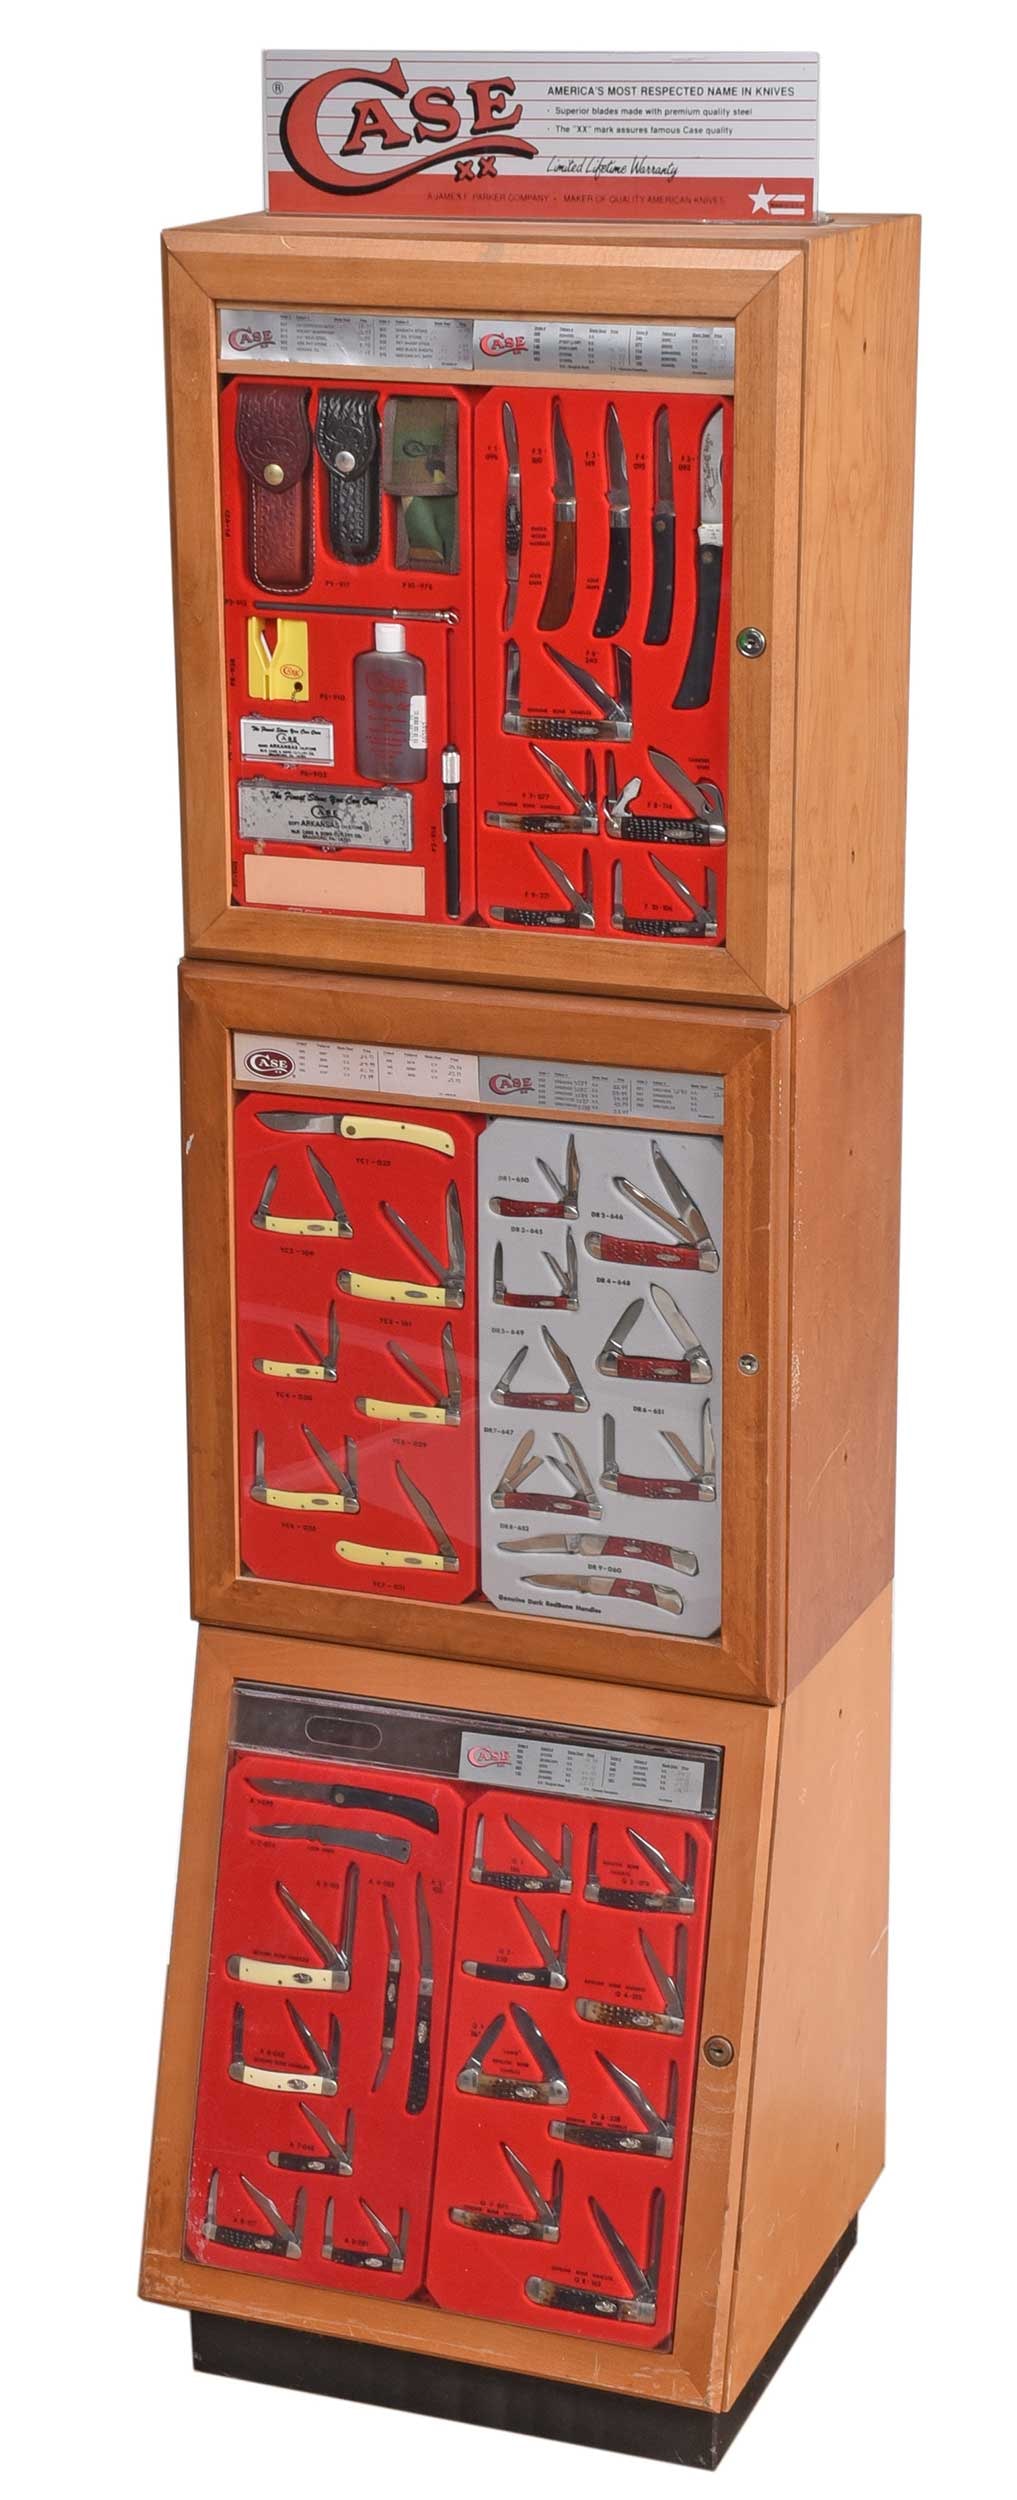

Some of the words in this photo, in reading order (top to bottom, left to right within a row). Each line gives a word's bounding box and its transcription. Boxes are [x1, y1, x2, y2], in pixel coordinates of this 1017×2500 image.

[547, 86, 604, 97] AMERICA'S
[607, 86, 637, 97] MOST
[640, 86, 704, 97] RESPECTED
[707, 86, 738, 97] NAME
[741, 86, 752, 97] IN
[755, 86, 795, 97] KNIVES
[555, 106, 589, 116] Superior
[592, 107, 618, 115] blades
[621, 107, 643, 116] made
[645, 107, 662, 116] with
[664, 107, 700, 117] premium
[703, 107, 730, 117] quality
[733, 108, 753, 116] steel
[279, 58, 539, 196] CASE
[555, 125, 570, 133] The
[594, 126, 614, 134] mark
[650, 126, 680, 134] famous
[683, 126, 703, 135] Case
[705, 126, 733, 136] quality
[546, 155, 587, 173] Limited
[585, 156, 627, 181] Lifetime
[630, 155, 679, 181] Warranty
[472, 192, 506, 201] PARKER
[506, 193, 549, 202] COMPANY
[563, 194, 593, 203] MAKER
[608, 195, 645, 204] QUALITY
[647, 195, 691, 205] AMERICAN
[228, 326, 276, 352] CASE
[480, 332, 528, 357] CASE
[270, 790, 282, 799] The
[284, 791, 305, 801] Finest
[300, 820, 339, 829] ARKANSAS
[250, 1053, 289, 1074] CASE
[488, 1073, 536, 1096] CASE
[498, 1594, 526, 1604] Genuine
[527, 1598, 543, 1606] Dark
[575, 1604, 602, 1614] Handles
[467, 1745, 512, 1768] CASE
